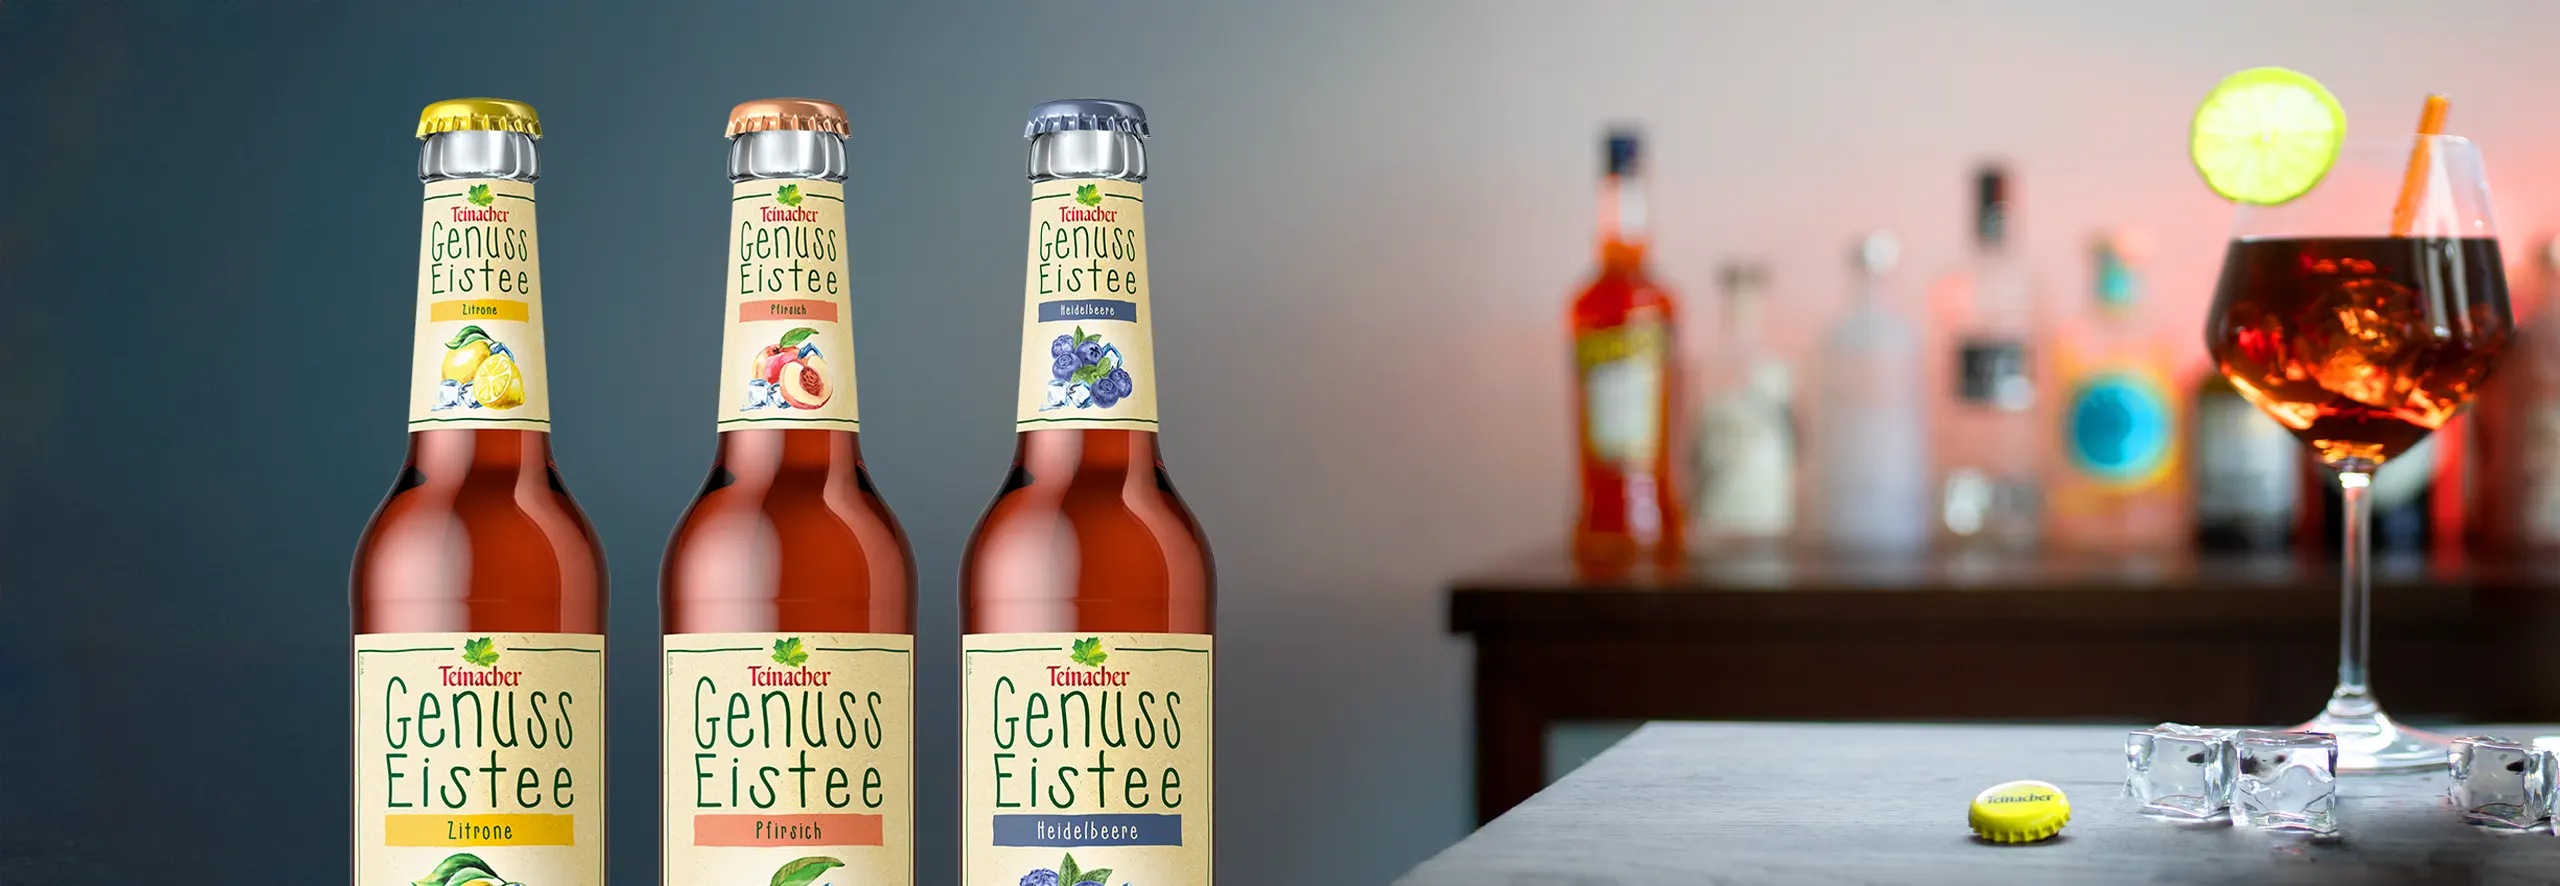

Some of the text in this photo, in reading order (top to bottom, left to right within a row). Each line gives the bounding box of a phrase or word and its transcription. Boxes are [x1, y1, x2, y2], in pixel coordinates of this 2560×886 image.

[451, 206, 510, 223] Teinacher
[759, 206, 819, 223] Teinacher
[1059, 206, 1118, 223] Teinacher
[431, 221, 528, 262] Genuss
[740, 221, 837, 262] Genuss
[1039, 221, 1136, 262] Genuss
[431, 259, 529, 295] Eistee
[740, 259, 838, 295] Eistee
[1039, 259, 1137, 295] Eistee
[462, 304, 498, 316] Zitrone
[770, 304, 807, 316] Pfirsich
[1060, 304, 1115, 316] Heidelbeere
[438, 666, 522, 687] Teinacher
[747, 666, 831, 687] Teinacher
[1046, 666, 1130, 687] Teinacher
[385, 676, 573, 749] Genuss
[694, 676, 882, 749] Genuss
[994, 676, 1181, 749] Genuss
[385, 750, 574, 809] Eistee
[694, 750, 883, 809] Eistee
[994, 750, 1182, 809] Eistee
[447, 821, 513, 840] Zitrone
[756, 821, 822, 840] Pfirsich
[1037, 821, 1139, 840] Heidelbeere
